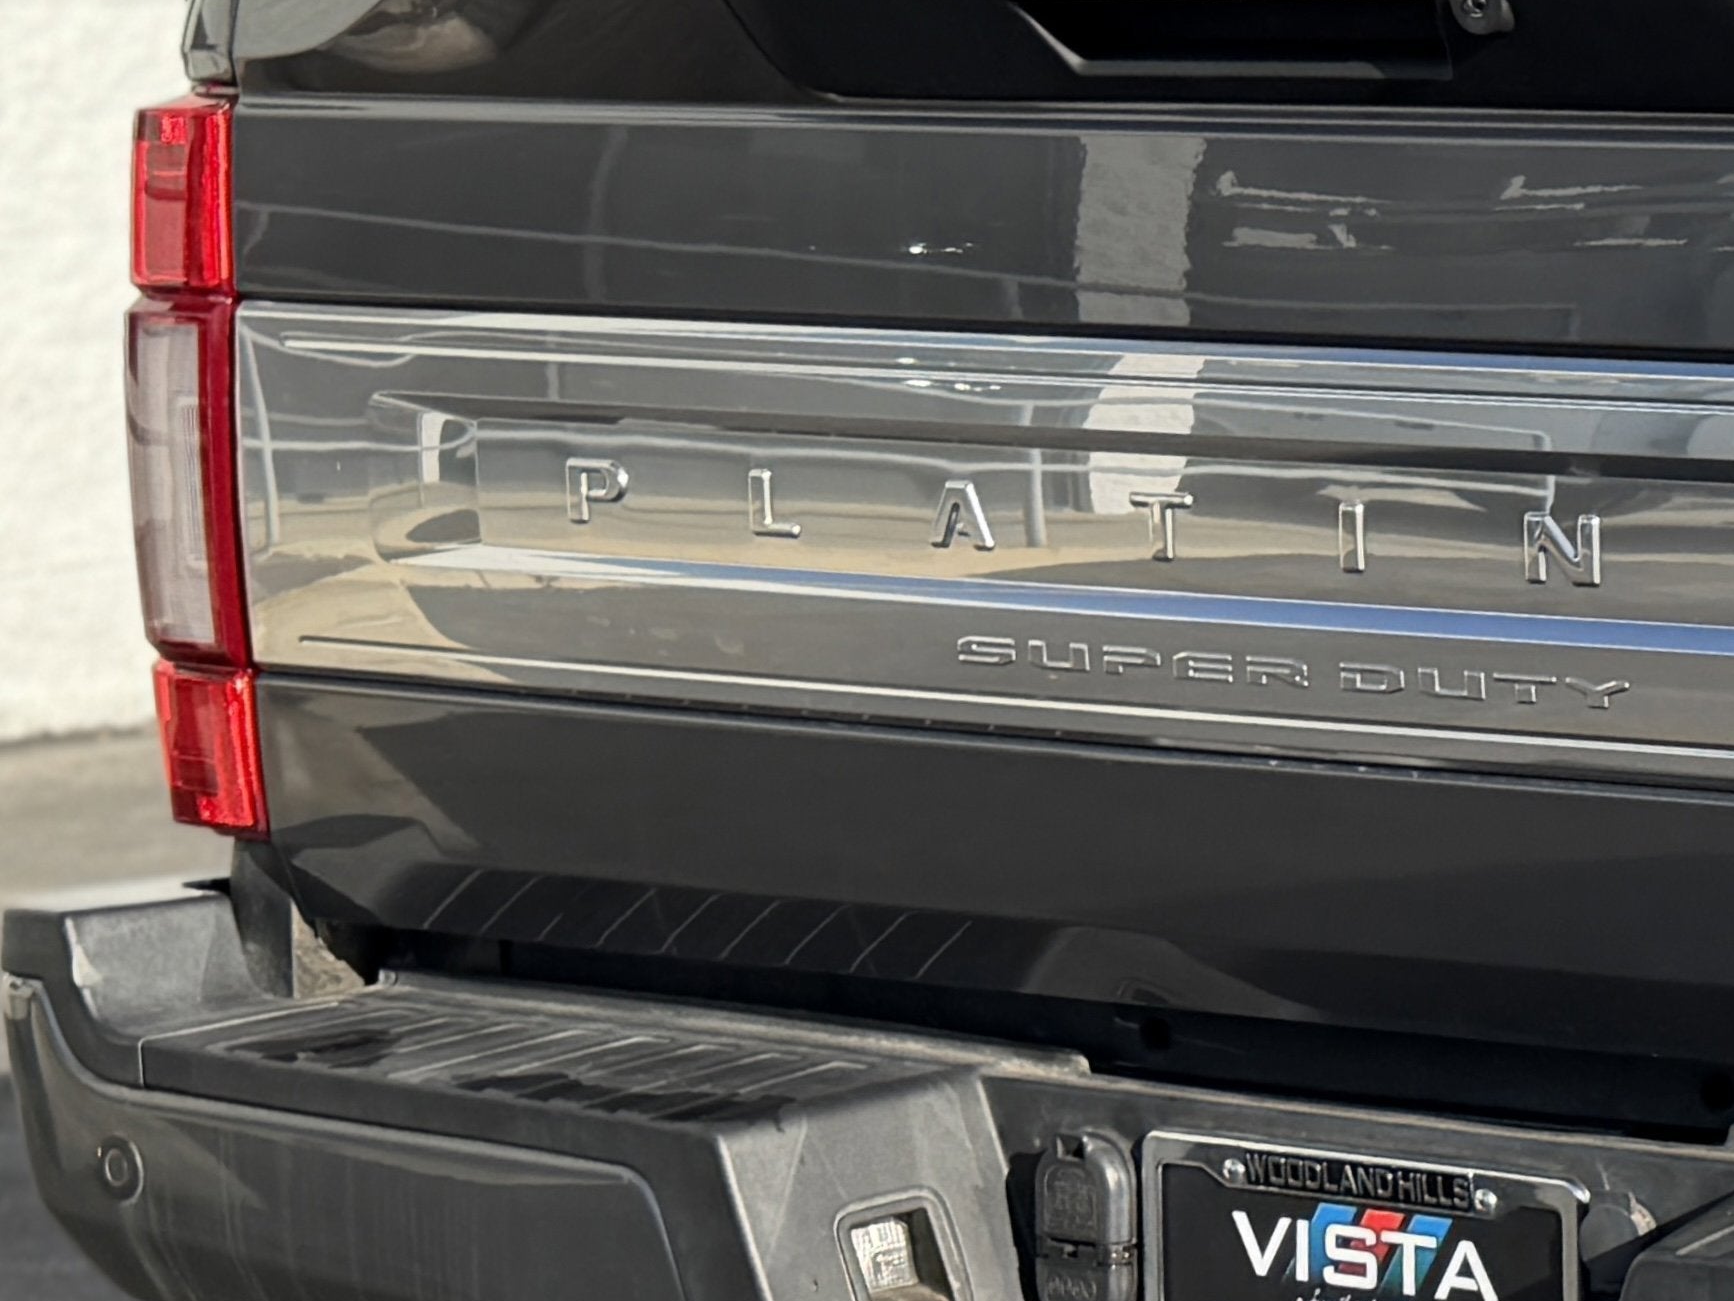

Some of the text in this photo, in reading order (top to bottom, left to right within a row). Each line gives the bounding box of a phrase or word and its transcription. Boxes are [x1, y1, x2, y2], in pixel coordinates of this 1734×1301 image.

[956, 634, 1630, 710] SUPER DUTY
[1246, 1152, 1470, 1208] WOODLAND HILLS
